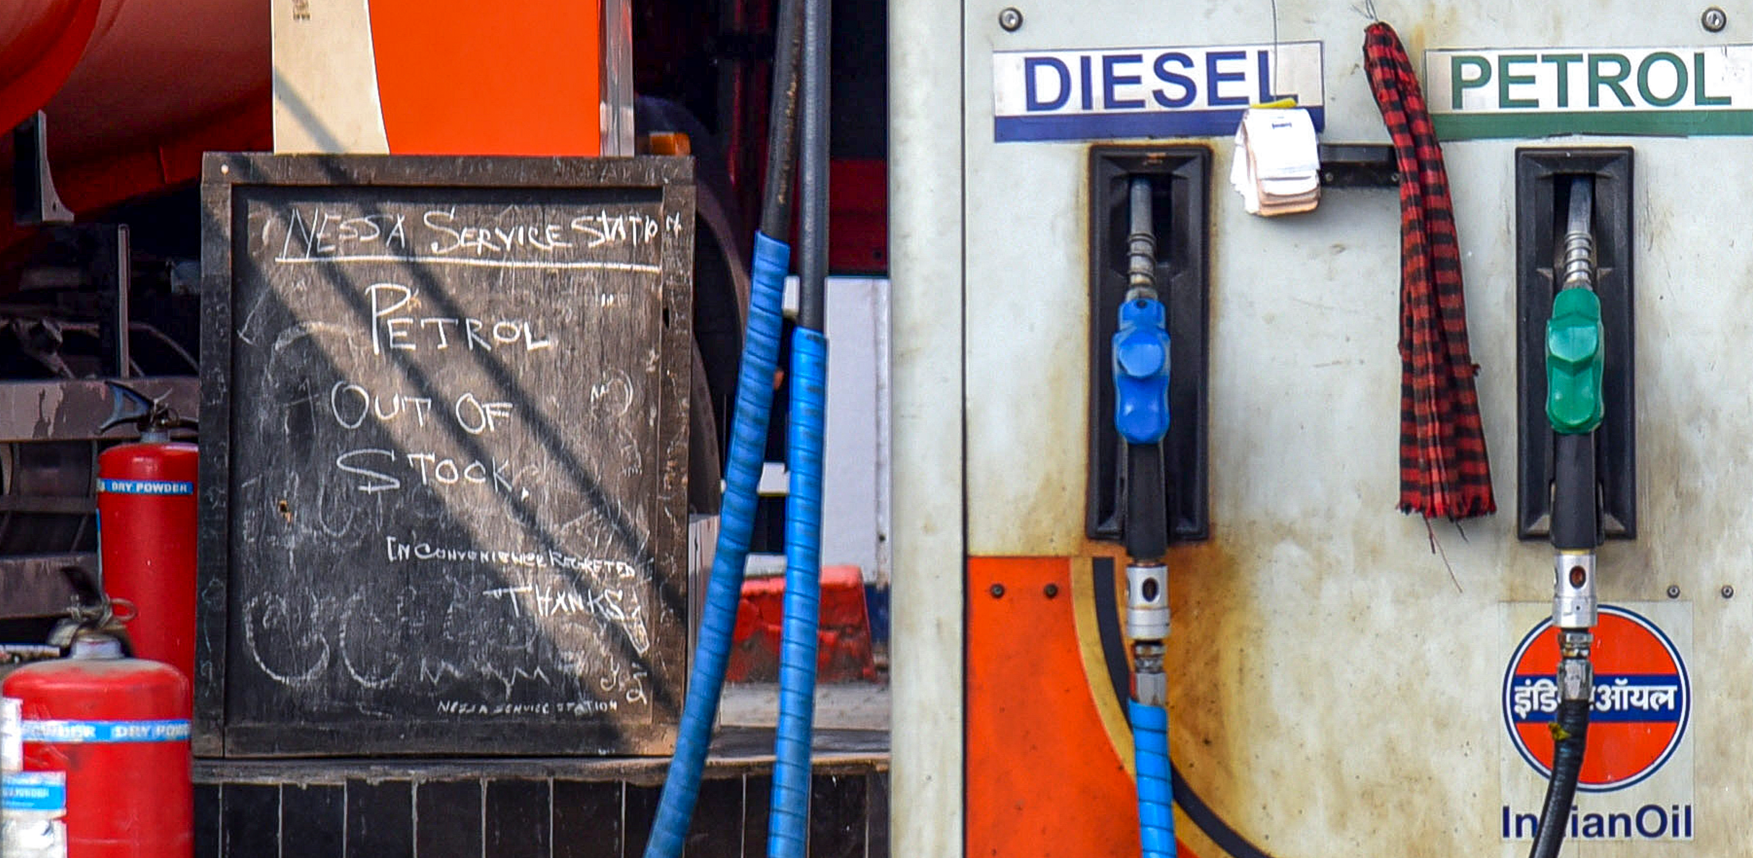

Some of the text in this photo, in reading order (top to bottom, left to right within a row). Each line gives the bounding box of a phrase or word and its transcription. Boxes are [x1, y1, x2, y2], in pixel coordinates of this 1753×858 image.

[1025, 51, 1298, 112] DIESEL
[1450, 52, 1732, 110] PETROL
[282, 207, 405, 260] NESSA
[424, 206, 572, 256] SERVICE
[365, 283, 550, 355] PETROL
[331, 380, 513, 434] OUT OF
[112, 481, 133, 493] DRY
[136, 482, 188, 494] POWDER
[1514, 677, 1678, 719] इंडिऑयल
[114, 723, 150, 738] DRY
[1502, 804, 1692, 839] InianOil
